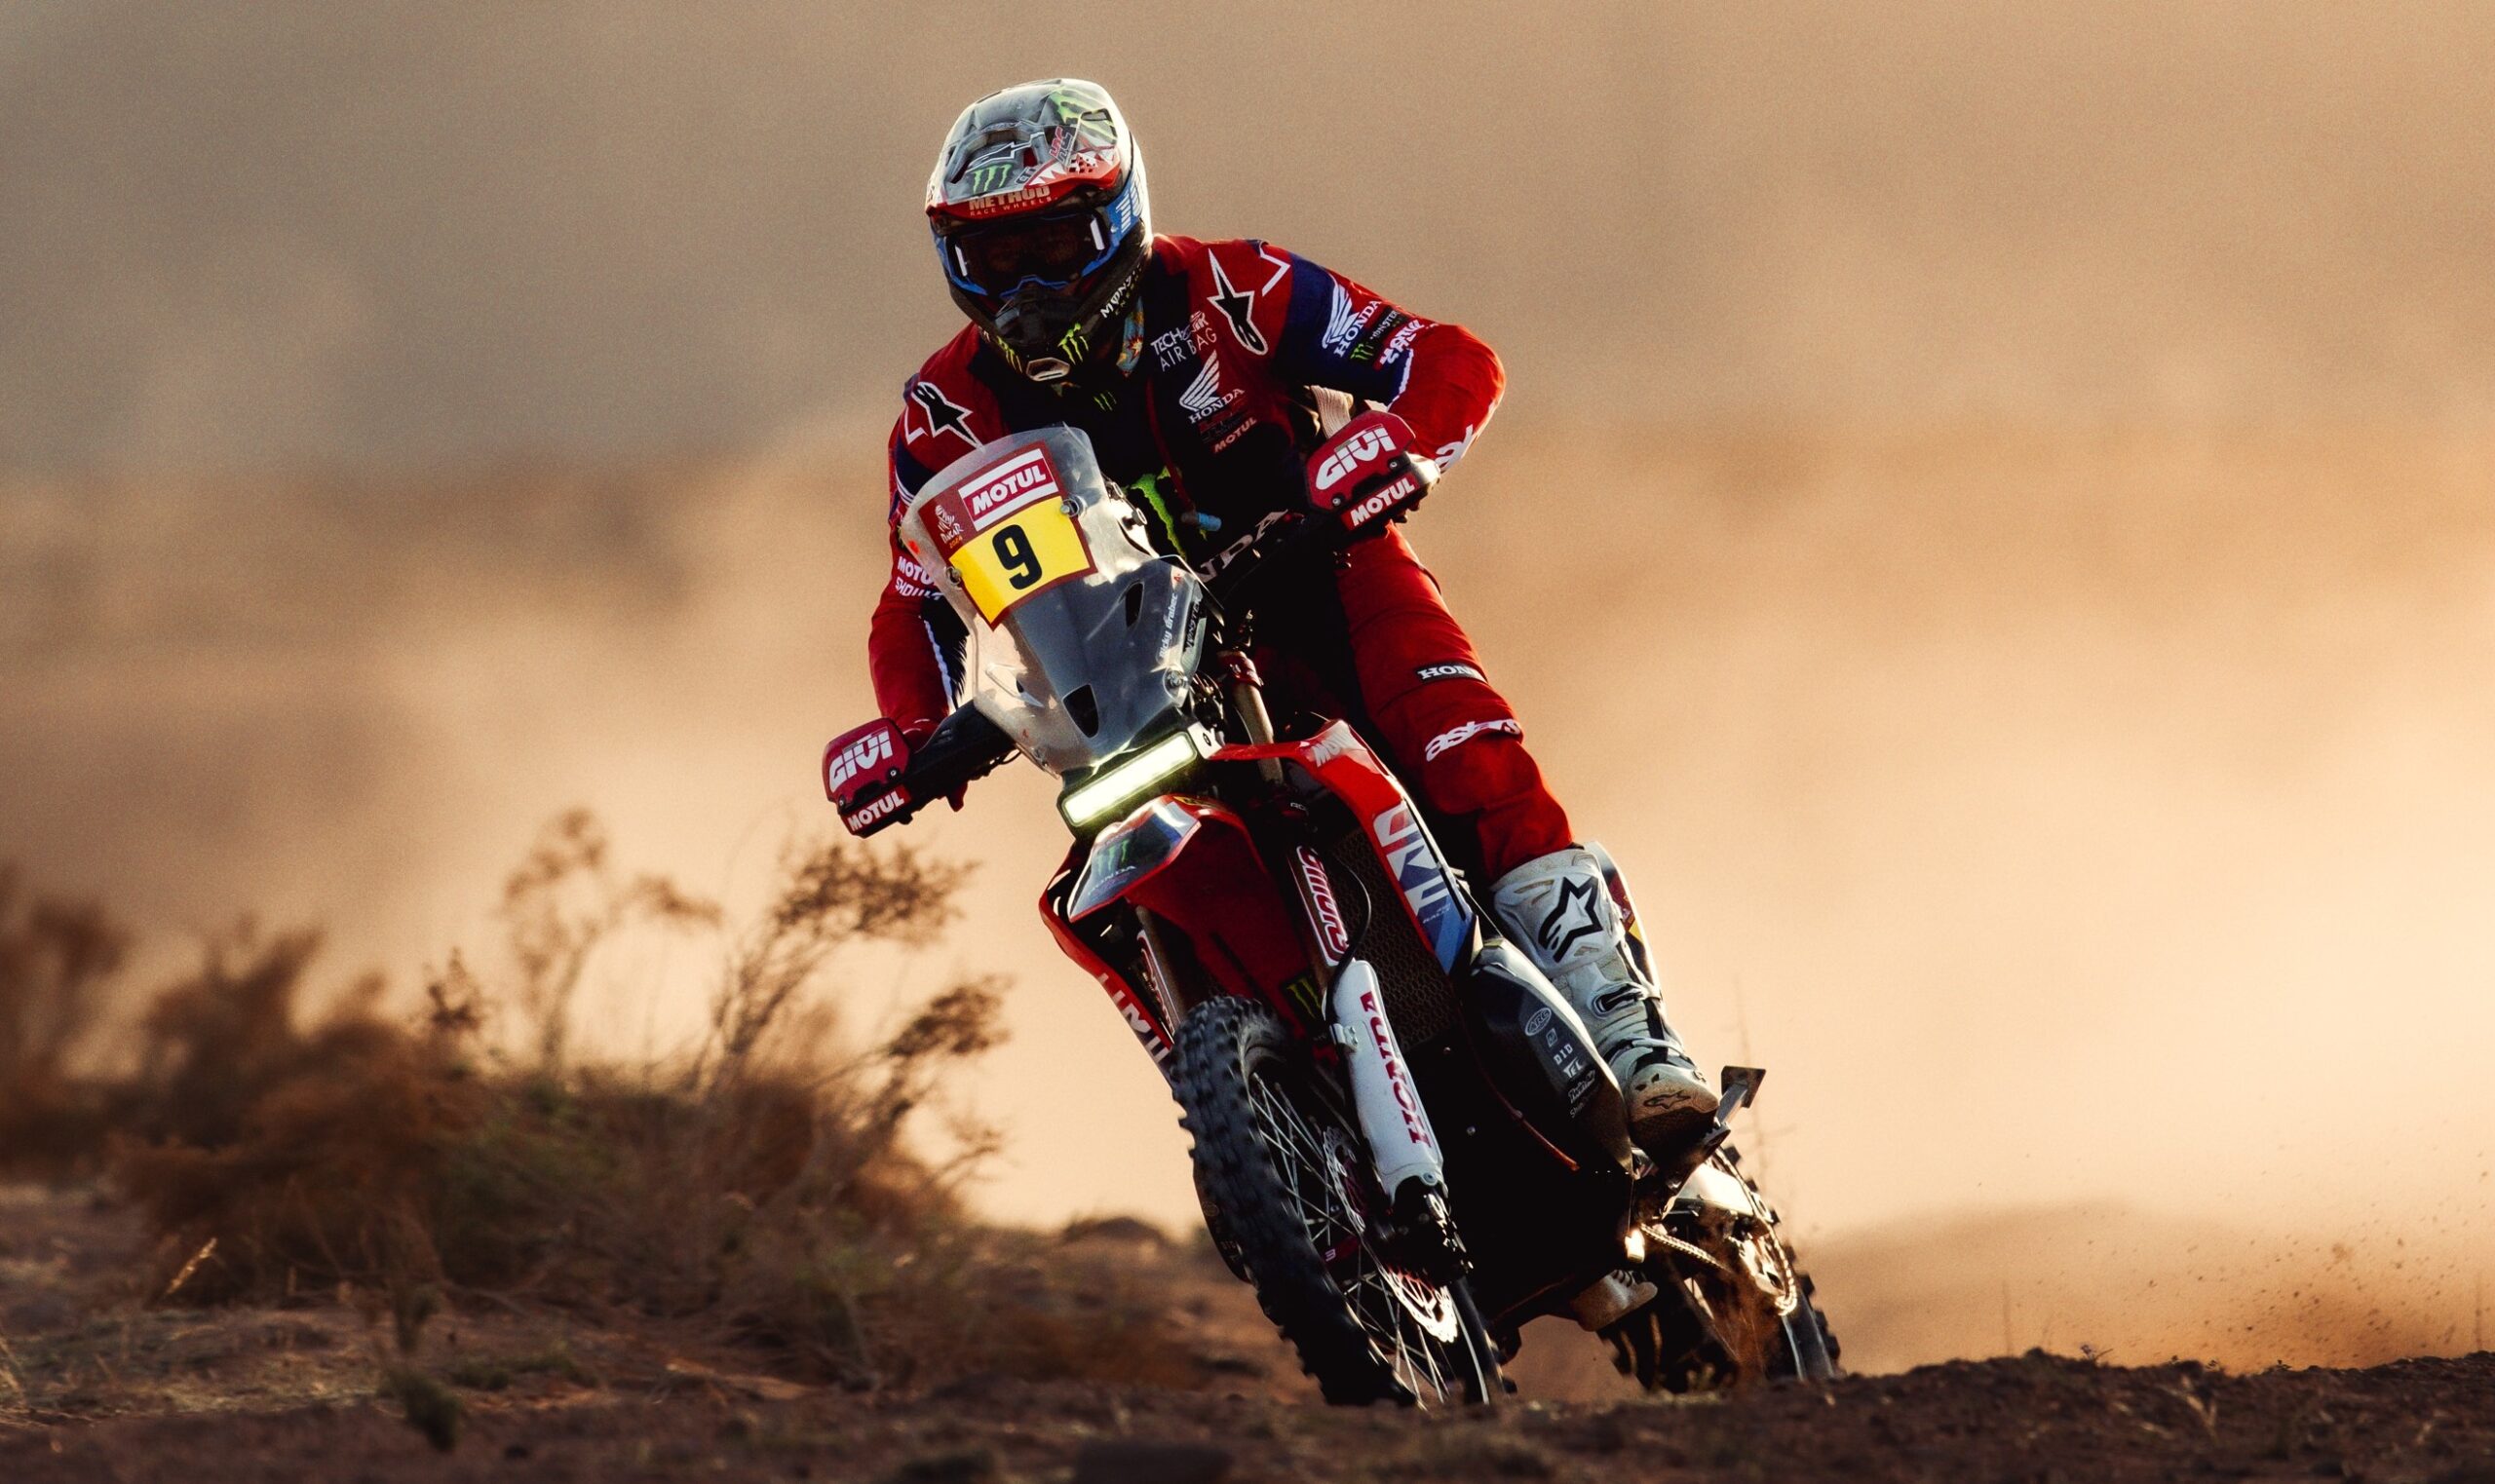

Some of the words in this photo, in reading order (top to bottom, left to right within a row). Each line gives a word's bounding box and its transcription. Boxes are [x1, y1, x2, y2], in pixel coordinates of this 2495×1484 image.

[968, 185, 1051, 210] METHOD
[1160, 346, 1187, 372] AIR
[1187, 327, 1217, 355] BAG
[1334, 300, 1382, 358] HONDA
[1188, 389, 1246, 424] HONDA
[1214, 417, 1257, 454] MOTUL
[1315, 426, 1397, 490] GIVI
[975, 465, 1046, 515] MOTUL
[1351, 476, 1415, 527] MOTUL
[898, 555, 935, 585] MOTU
[992, 524, 1043, 590] 9
[1196, 509, 1288, 584] NDA
[829, 731, 893, 793] GIVI
[847, 791, 905, 831] MOTUL
[1361, 991, 1432, 1149] HONDA
